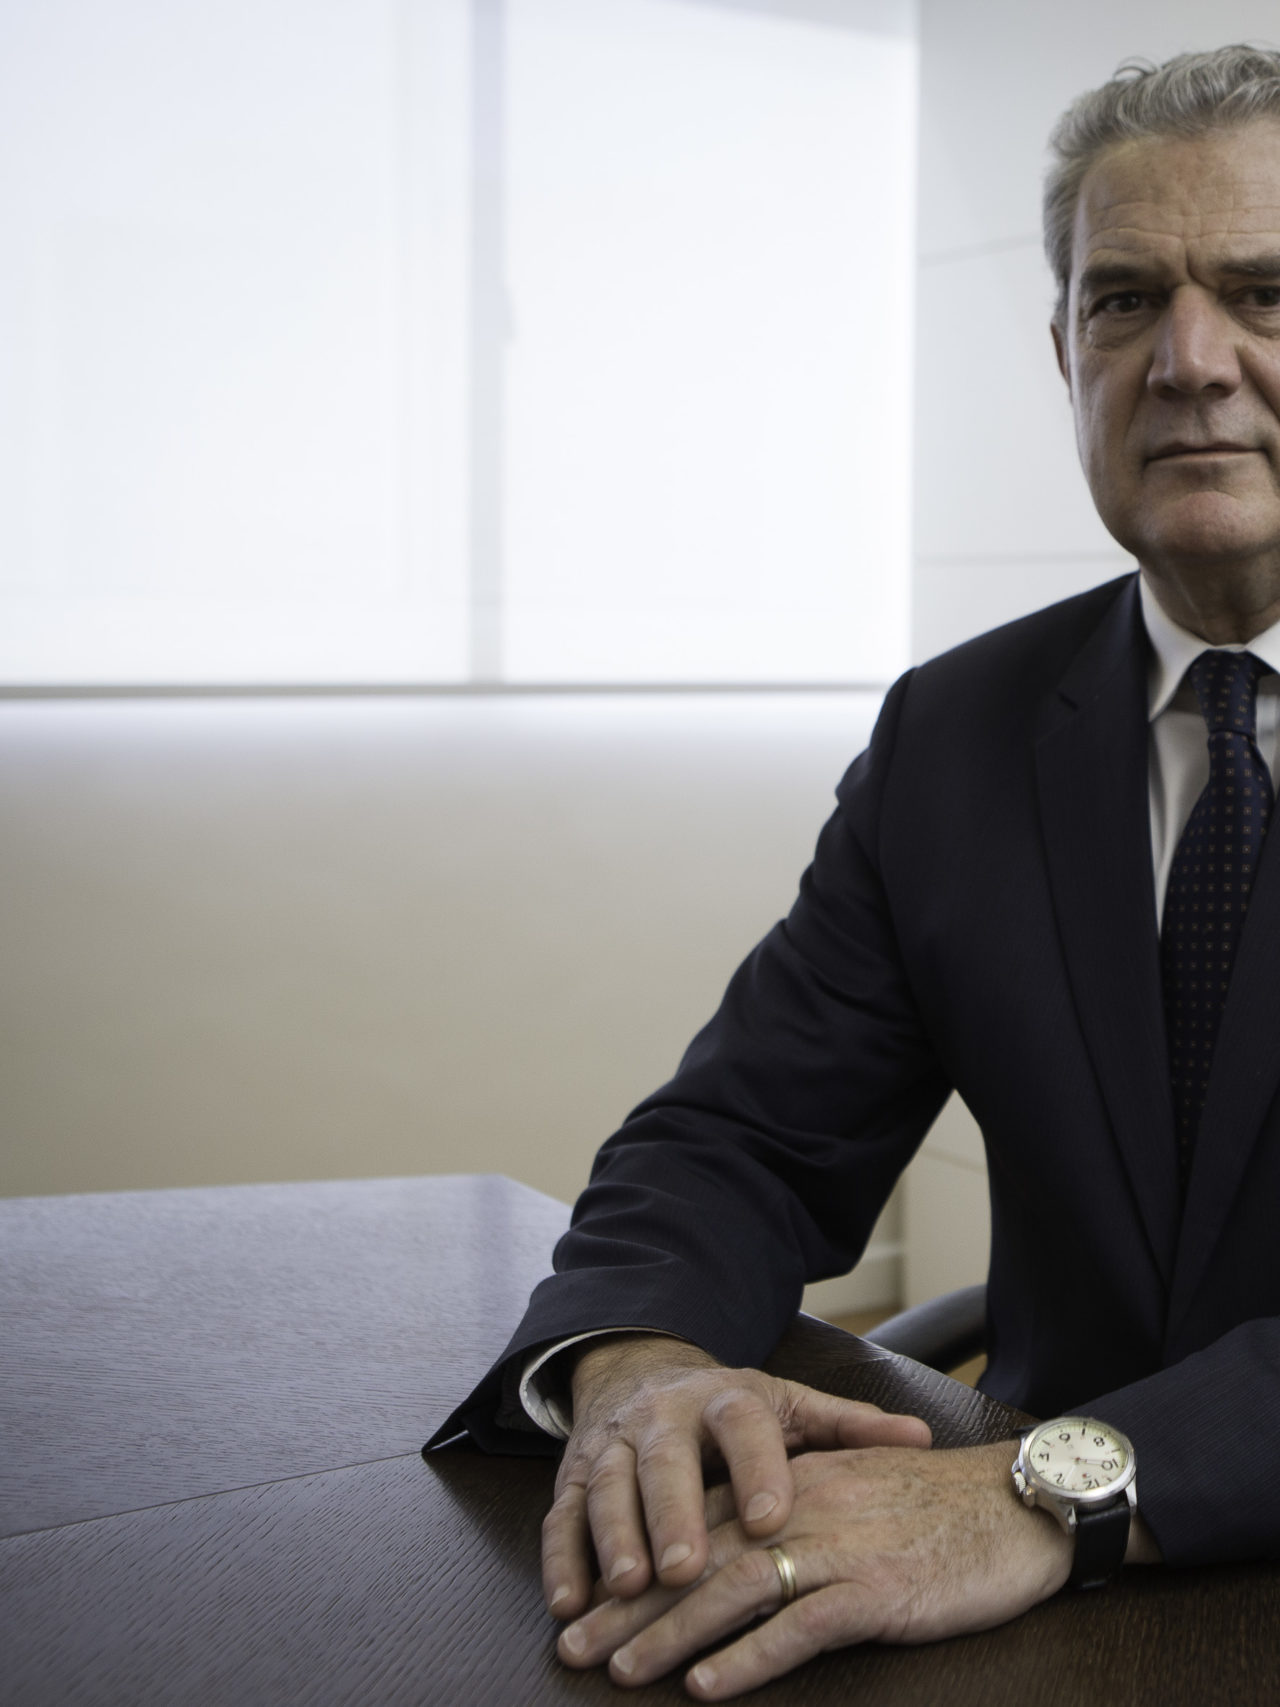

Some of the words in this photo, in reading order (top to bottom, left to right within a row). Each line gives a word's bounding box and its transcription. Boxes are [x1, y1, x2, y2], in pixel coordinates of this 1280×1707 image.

[1093, 1436, 1105, 1447] 8
[1101, 1458, 1119, 1471] 10
[1054, 1473, 1065, 1485] 2
[1083, 1478, 1100, 1491] 12
